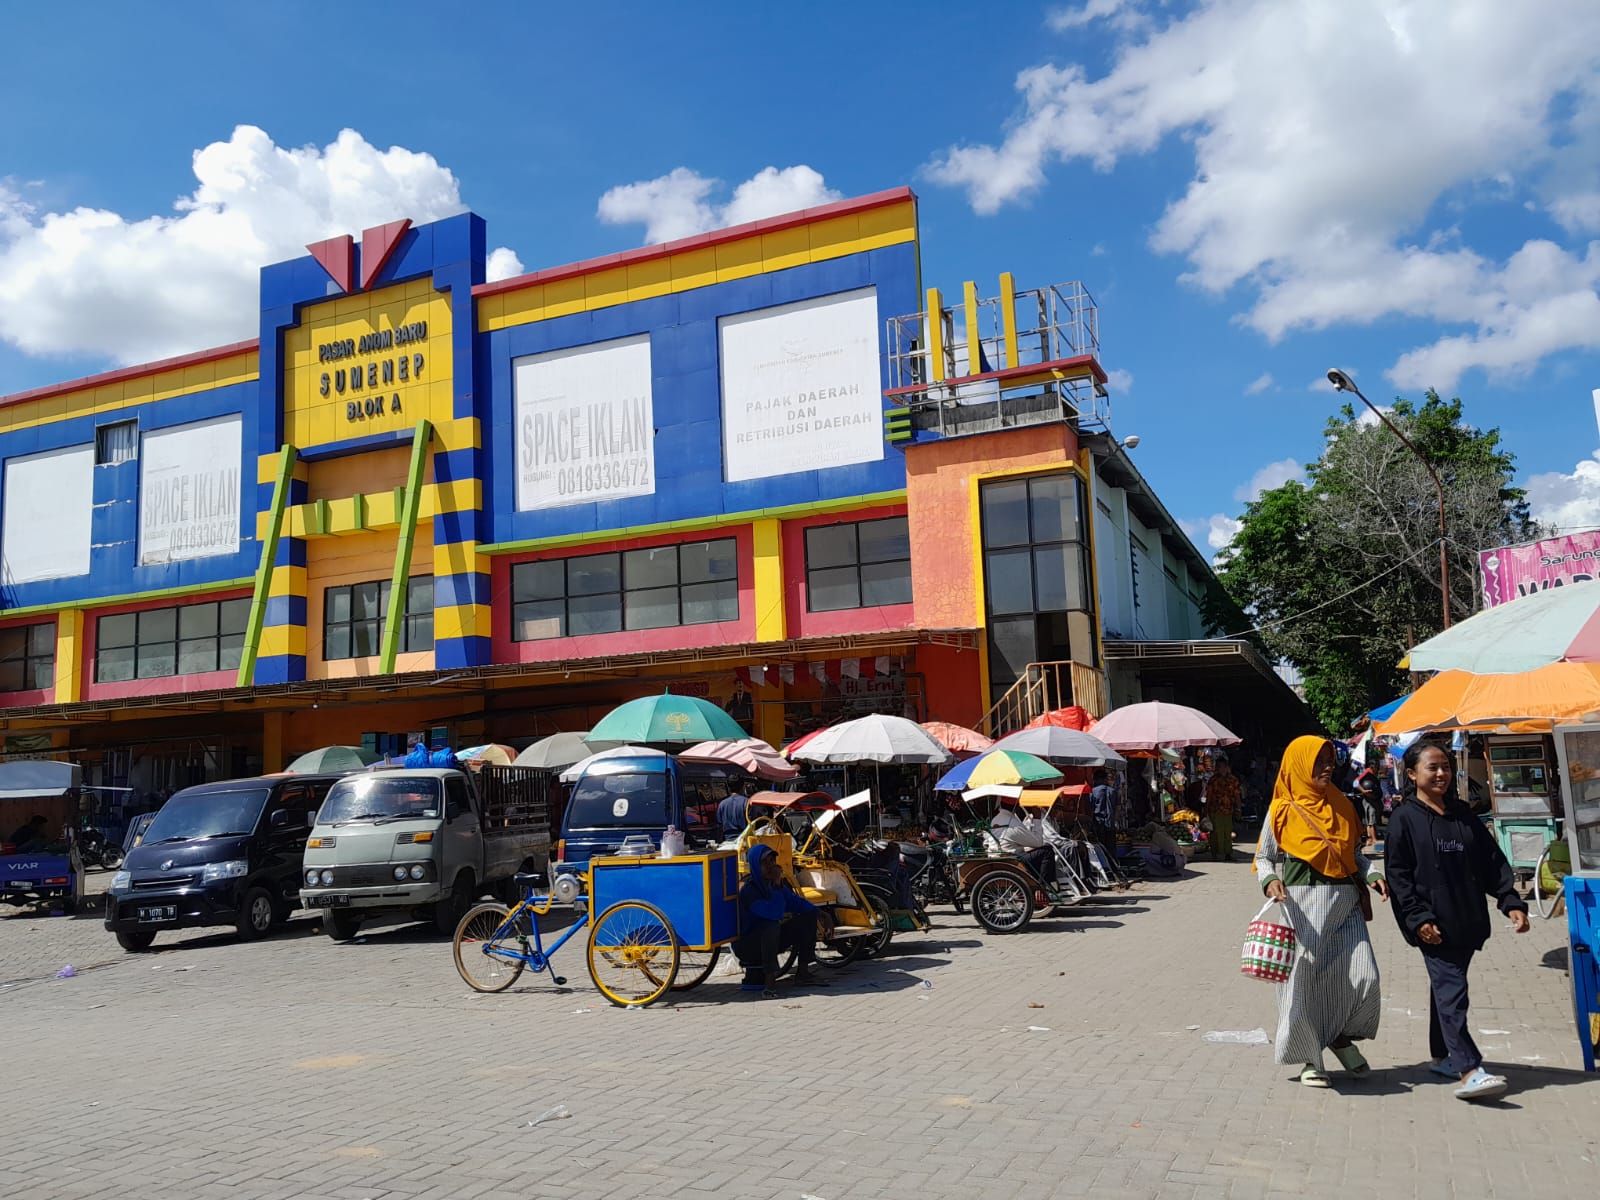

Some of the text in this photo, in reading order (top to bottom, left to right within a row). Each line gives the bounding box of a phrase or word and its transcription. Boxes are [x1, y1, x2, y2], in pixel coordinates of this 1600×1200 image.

[319, 320, 427, 362] PASAR ANOM BARU
[319, 353, 425, 396] SUMENEP
[346, 393, 402, 421] BLOK A
[746, 384, 860, 413] PAJAK DAERAH
[787, 406, 817, 421] DAN
[522, 396, 647, 469] SPACE IKLAN
[736, 412, 872, 444] RETRIBUSI DAERAH
[558, 457, 649, 495] 0818336472
[145, 467, 238, 529] SPACE IKLAN
[8, 862, 39, 870] VIAR
